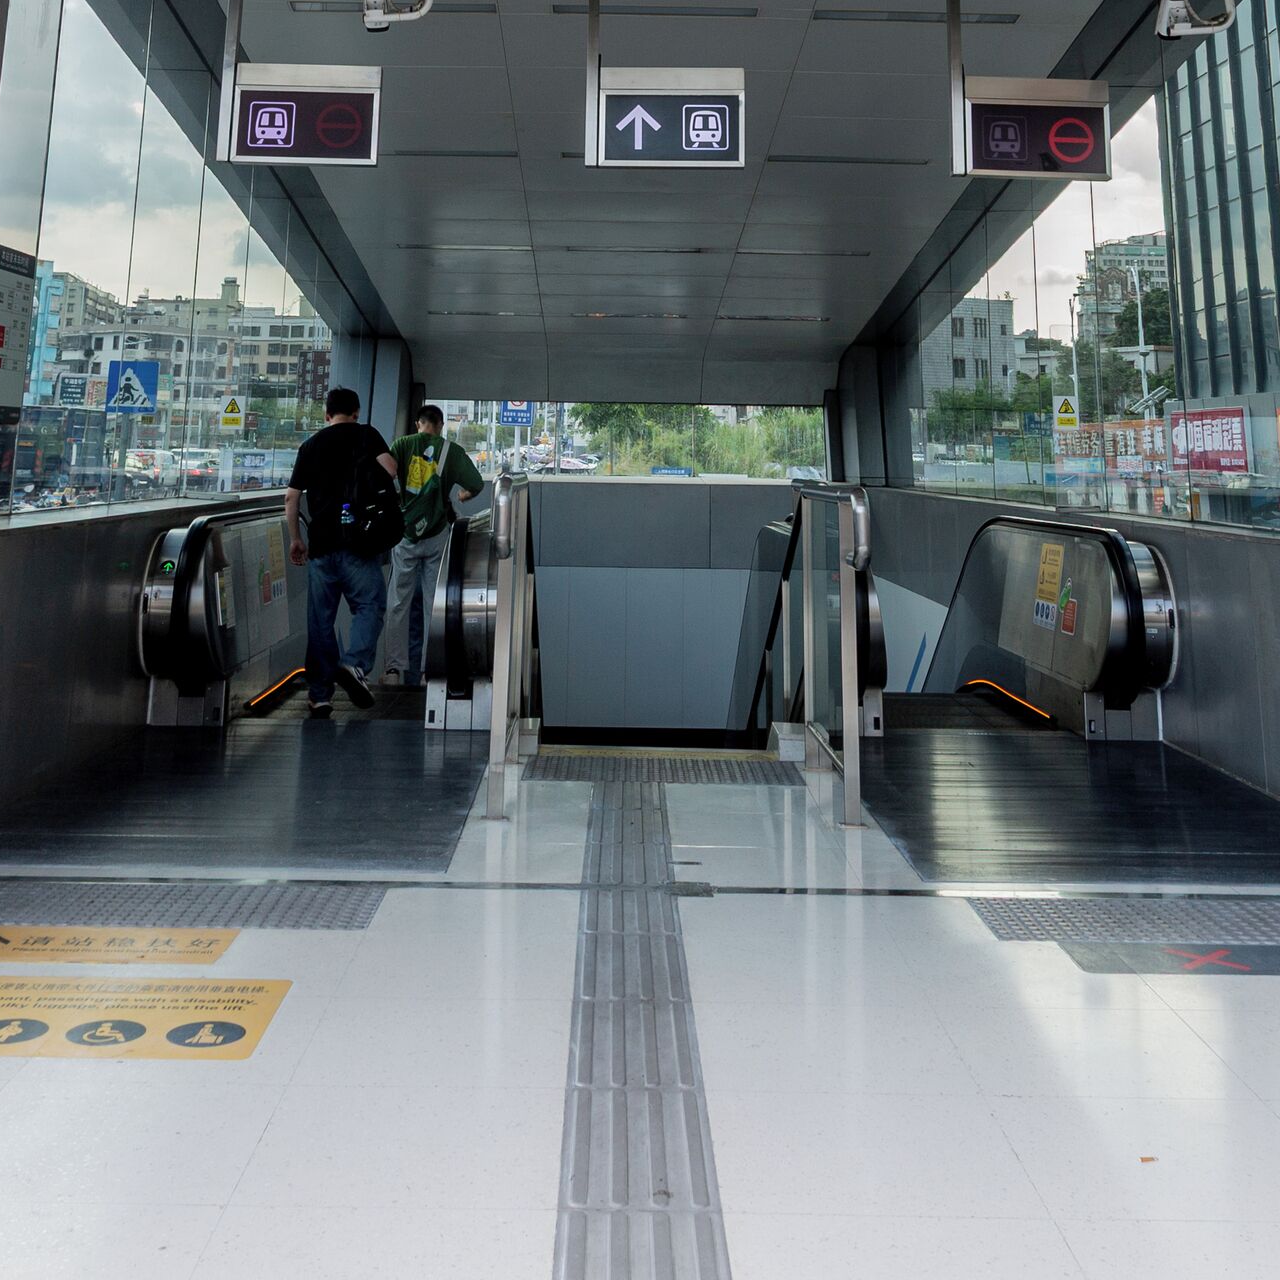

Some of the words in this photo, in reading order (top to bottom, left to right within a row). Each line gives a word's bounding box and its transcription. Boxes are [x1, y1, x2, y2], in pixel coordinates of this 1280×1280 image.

[21, 935, 221, 948] 请站稳扶好
[183, 997, 258, 1006] disability,
